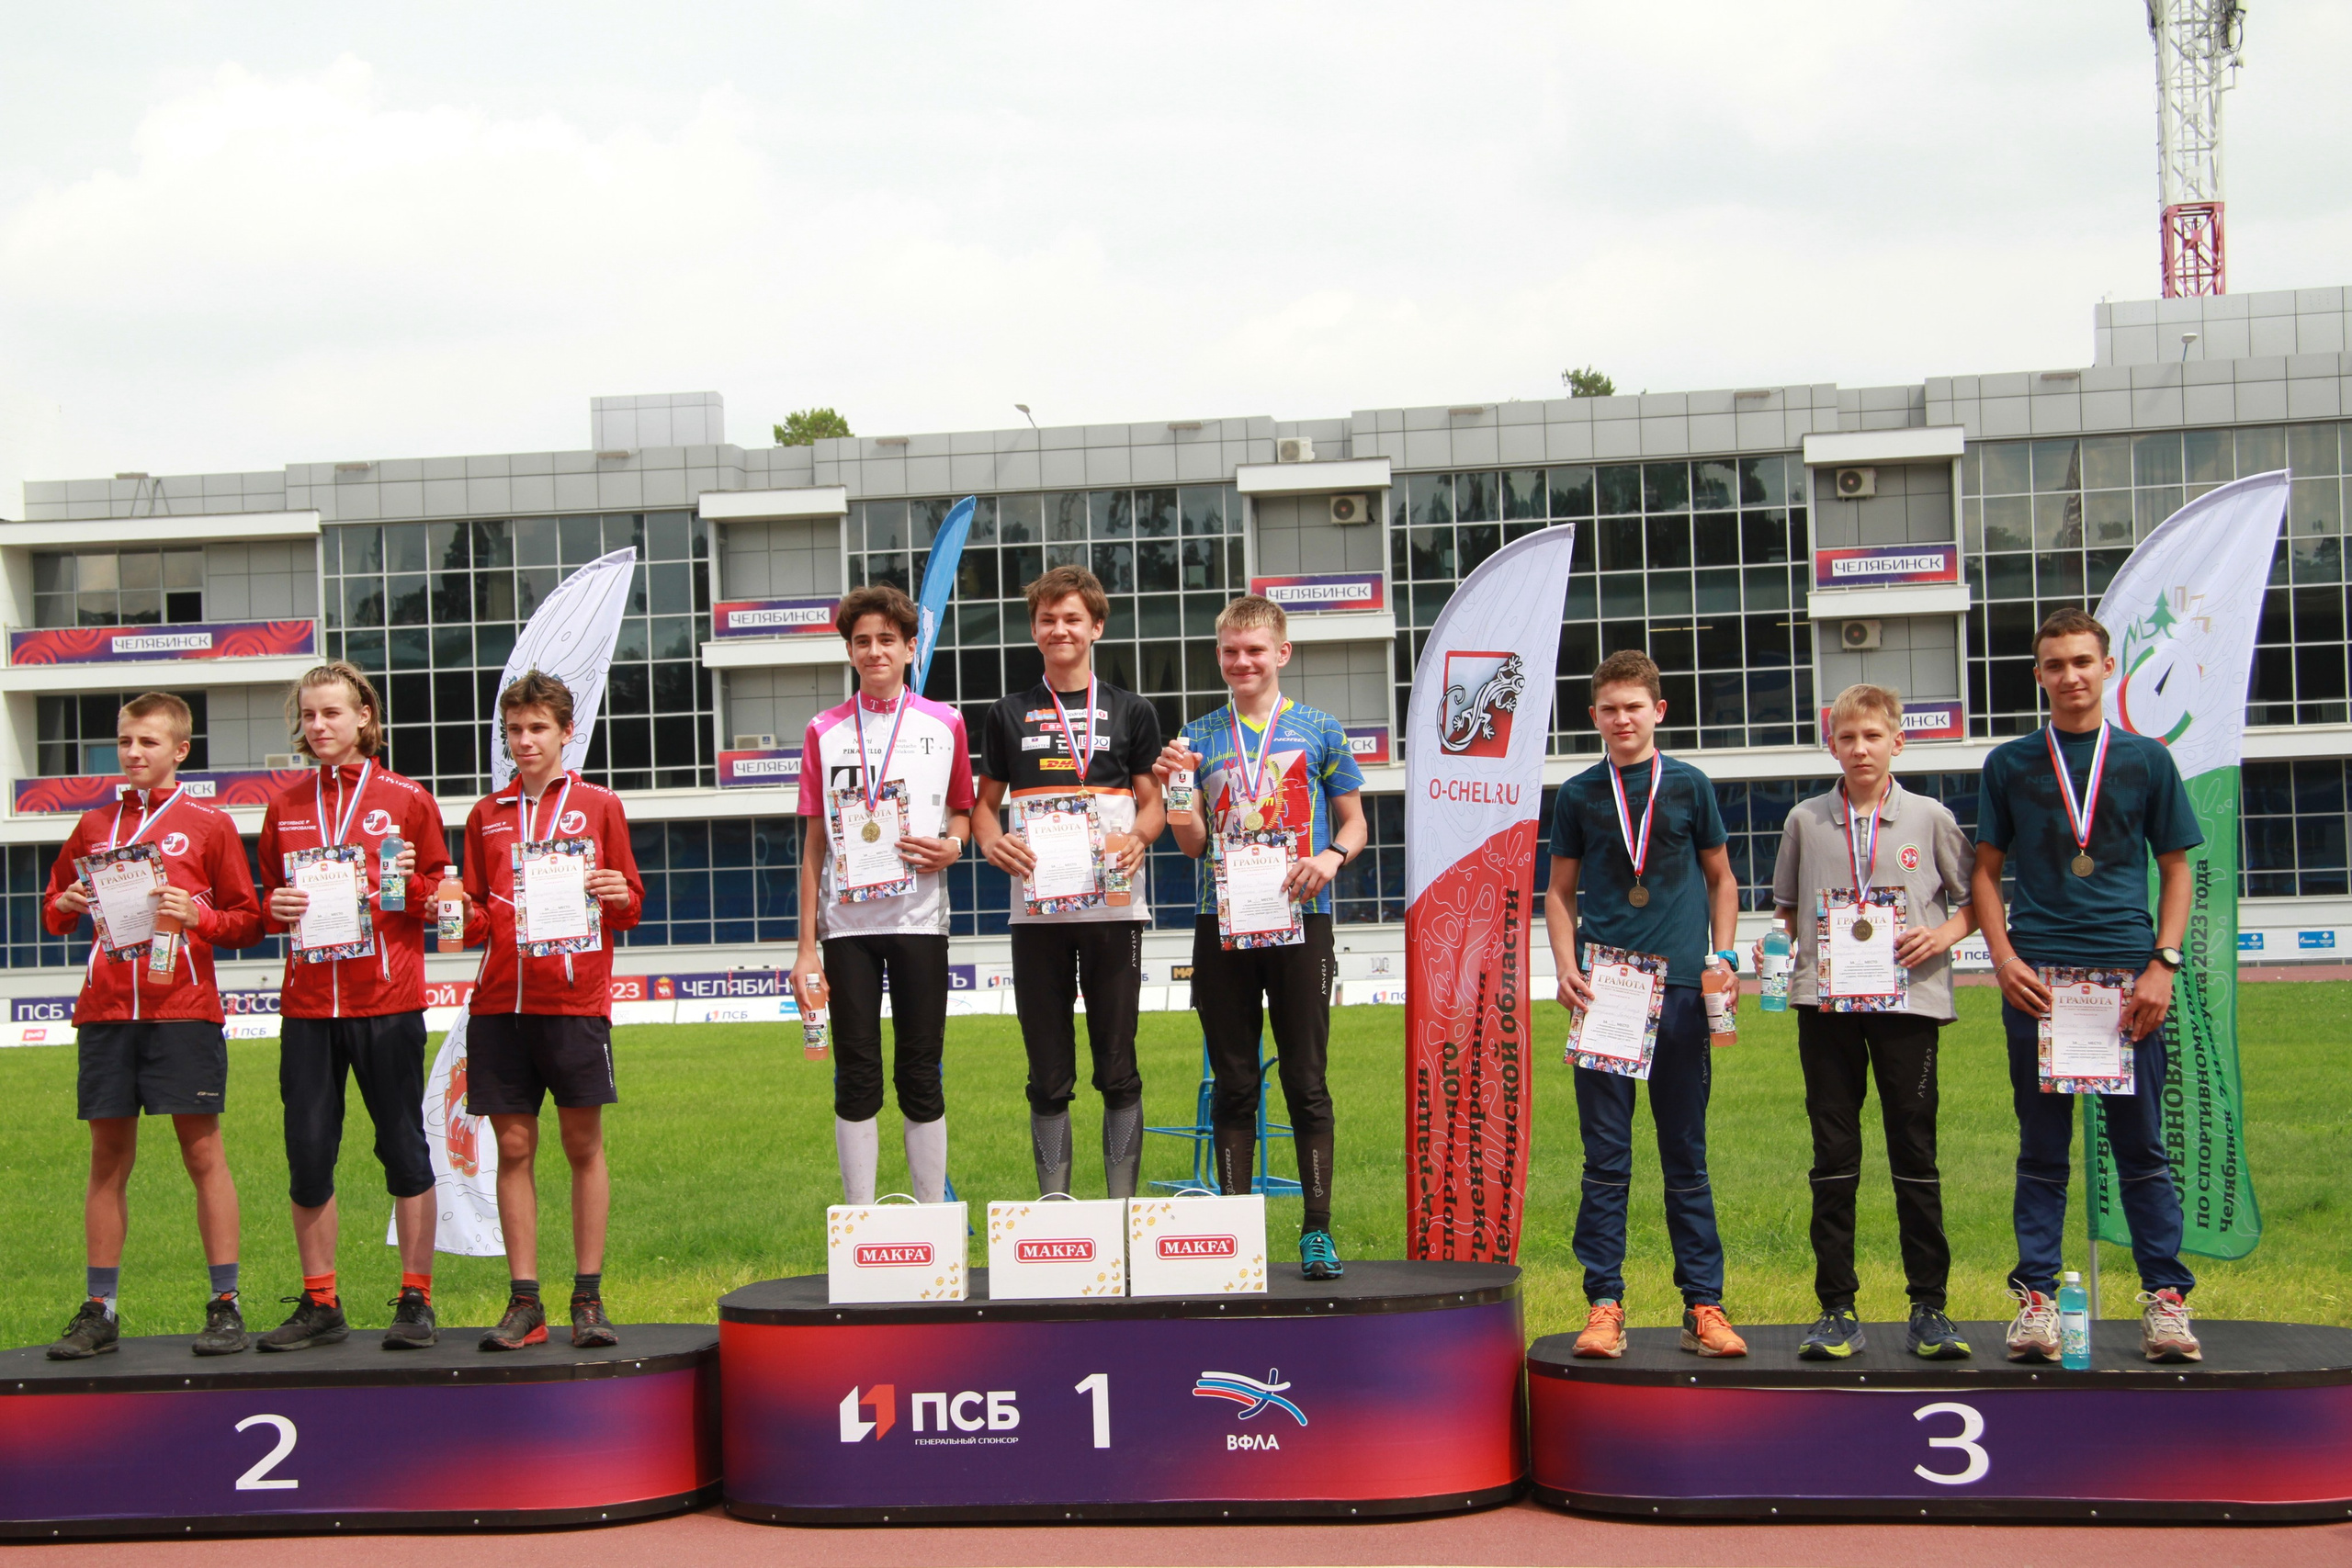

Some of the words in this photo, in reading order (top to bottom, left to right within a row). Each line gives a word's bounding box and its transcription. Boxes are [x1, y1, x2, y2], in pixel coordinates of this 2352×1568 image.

[1835, 557, 1940, 573] ЧЕЛЯБИНСК
[1268, 586, 1369, 600] ЧЕЛЯБИНСК
[731, 610, 827, 625] ЧЕЛЯБИНСК
[114, 635, 209, 650] ЧЕЛЯБИНСК
[736, 760, 799, 773] ЧЕЛЯБИ
[1429, 778, 1520, 806] O-CHEL.RU
[1035, 823, 1080, 834] ГРАМОТА
[1233, 856, 1280, 867] ГРАМОТА
[302, 871, 348, 884] ГРАМОТА
[531, 864, 577, 876] ГРАМОТА
[98, 870, 147, 886] ГРАМОТА
[2195, 859, 2211, 910] года
[2191, 914, 2208, 967] 2023
[1496, 889, 1520, 1033] области
[1964, 951, 1990, 960] ПСБ
[1598, 975, 1645, 990] ГРАМОТА
[2059, 996, 2112, 1006] ГРАМОТА
[17, 1003, 64, 1021] ПСБ
[722, 1010, 748, 1020] ПСБ
[241, 1027, 266, 1036] ПСБ
[2191, 1020, 2211, 1192] СПОРТИВНОМУ
[2096, 1100, 2109, 1216] ПЕРВЕН
[2220, 1109, 2236, 1233] Челябинск
[2197, 1200, 2210, 1229] ПО
[1023, 1244, 1085, 1258] MAKFA
[1164, 1240, 1227, 1255] MAKFA
[862, 1248, 923, 1263] MAKFA
[911, 1391, 1021, 1431] ПСБ
[1074, 1373, 1110, 1449] 1
[915, 1436, 977, 1447] ГЕНЕРАЛЬНЫЙ
[978, 1436, 1020, 1446] СПОНСОР
[1227, 1434, 1280, 1450] ВФЛА
[1912, 1402, 1989, 1484] 3
[234, 1414, 299, 1490] 2
